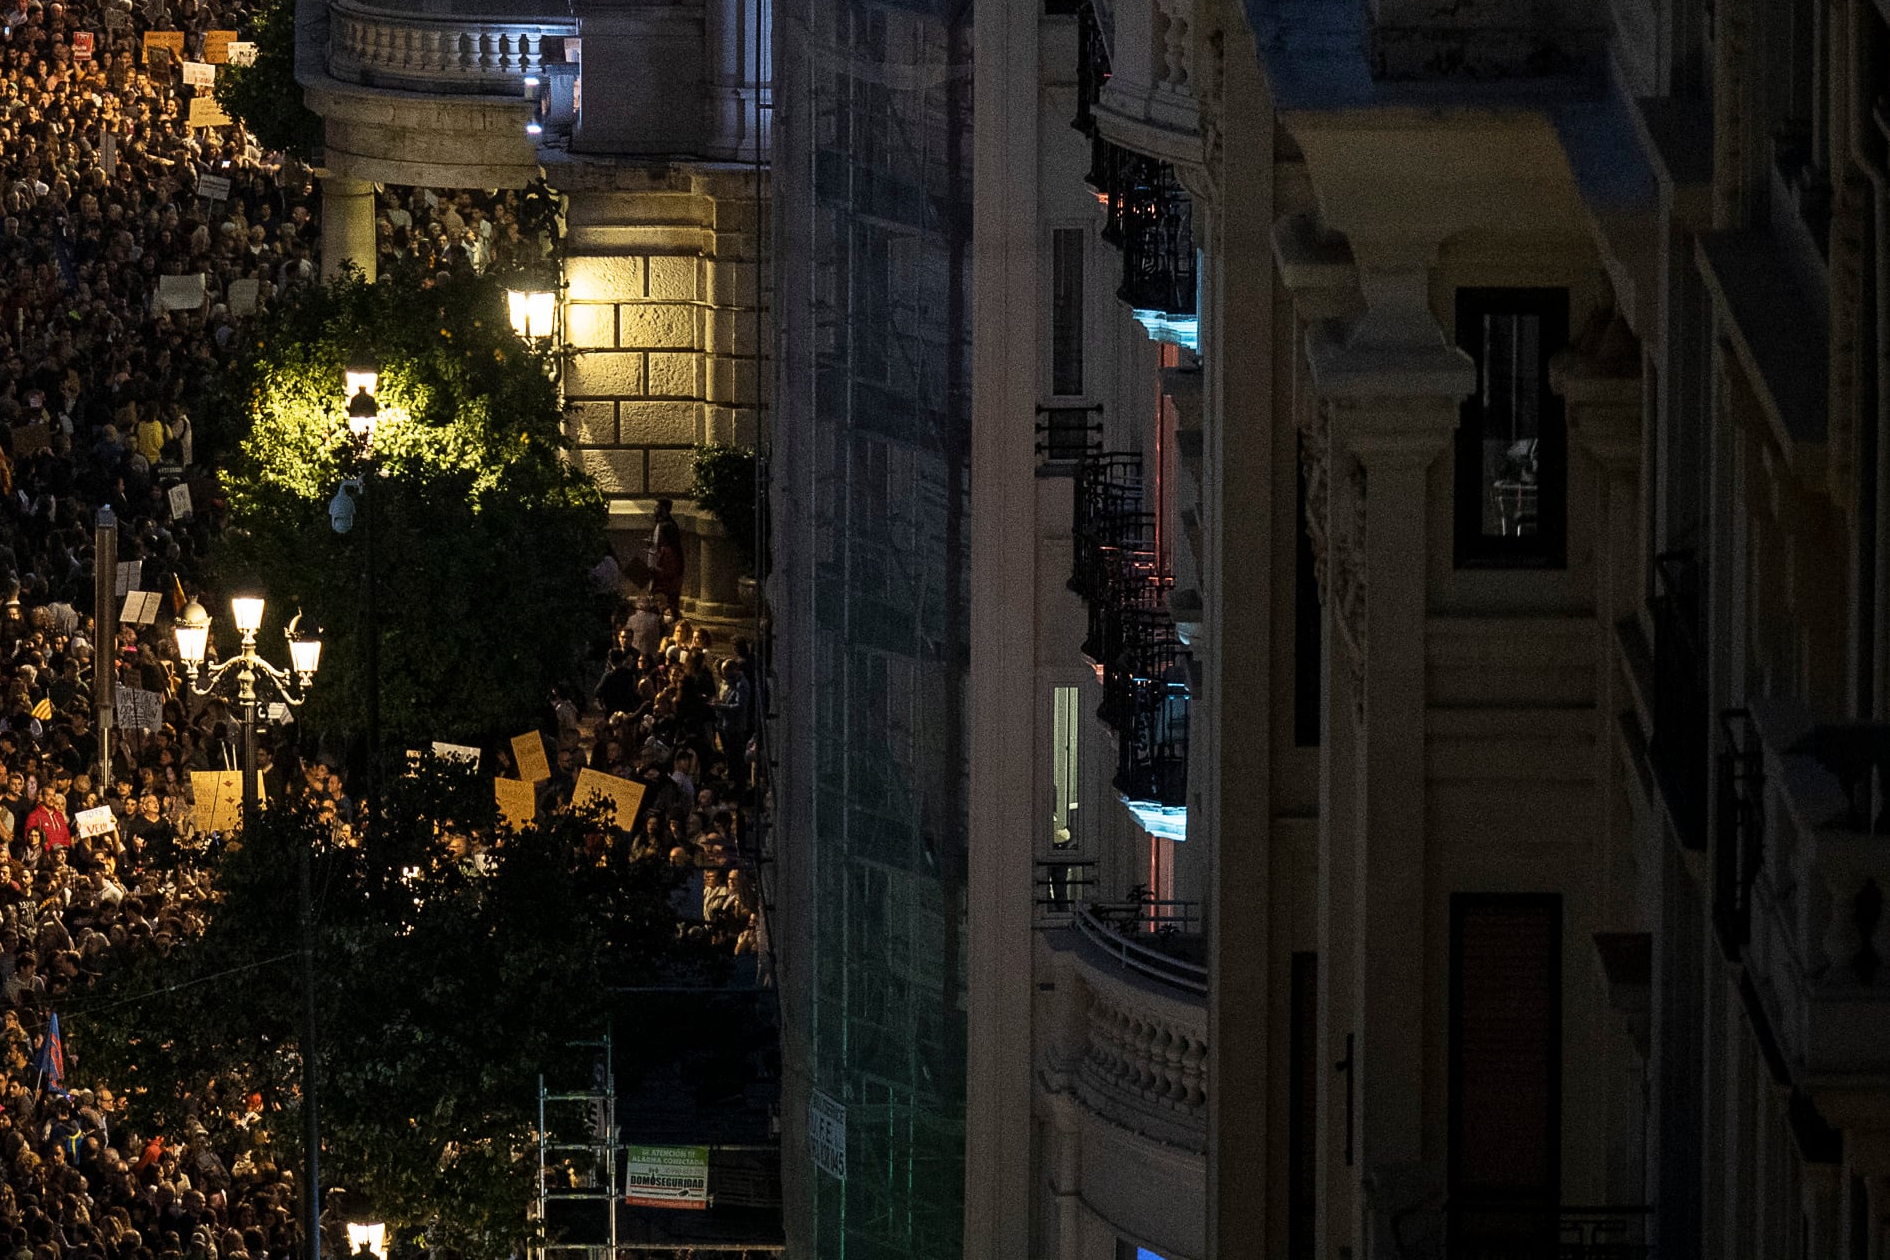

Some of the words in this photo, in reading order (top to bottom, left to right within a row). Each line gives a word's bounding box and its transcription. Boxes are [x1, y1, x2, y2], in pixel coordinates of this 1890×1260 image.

[652, 1148, 687, 1158] ATENCIÓN
[664, 1157, 704, 1165] CONECTADA
[630, 1175, 704, 1188] DOMOSEGURIDAD
